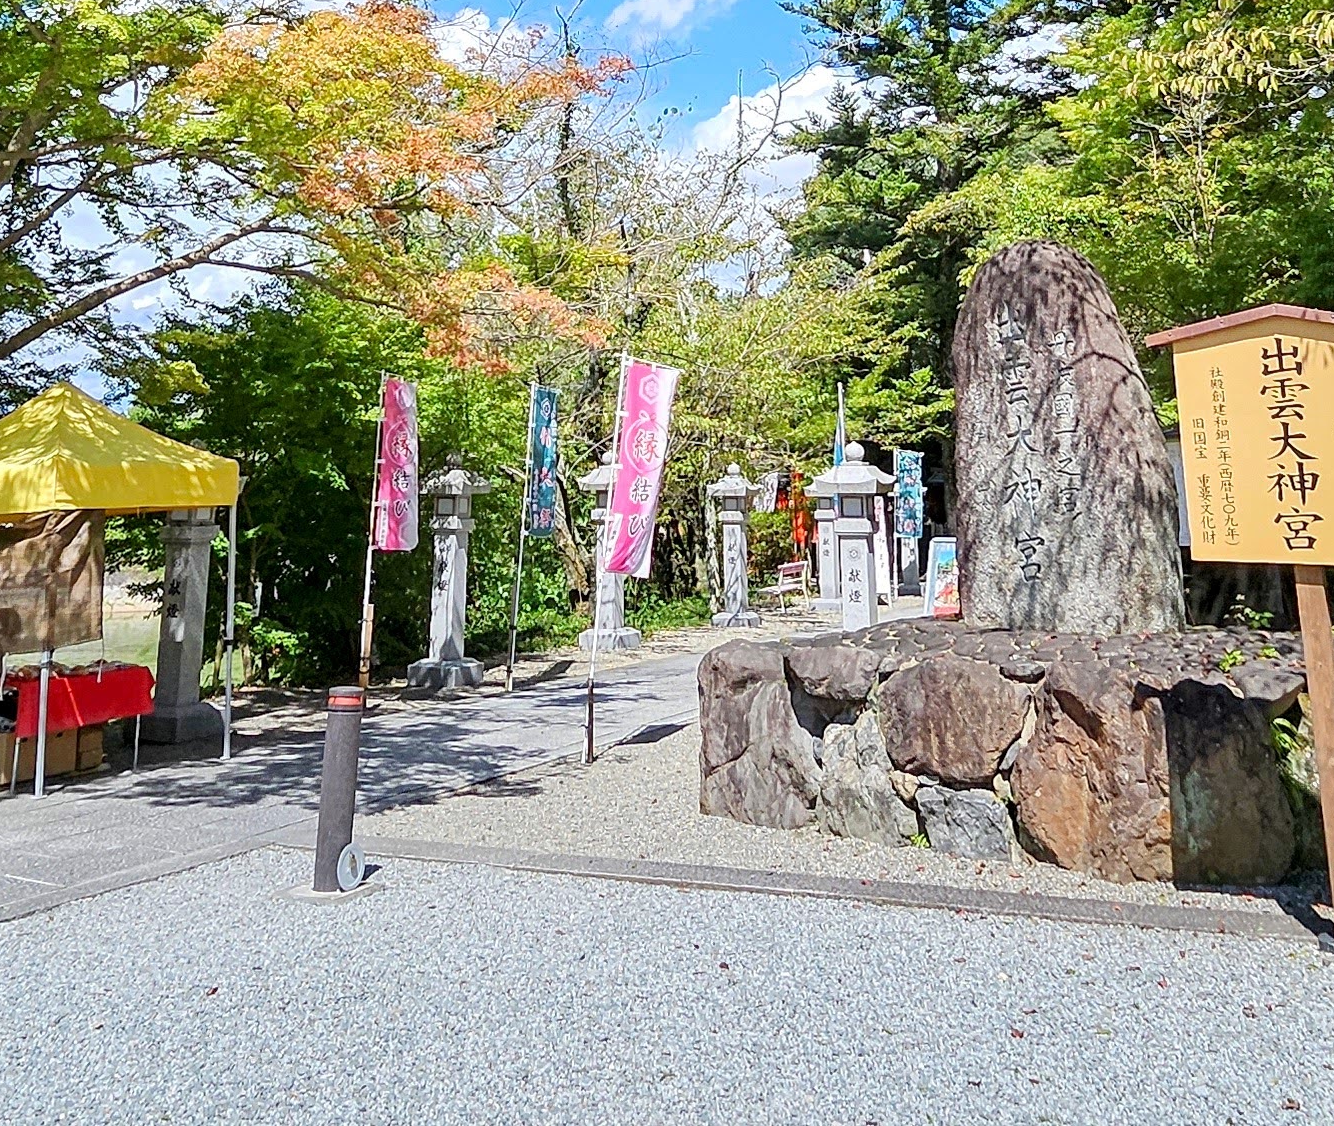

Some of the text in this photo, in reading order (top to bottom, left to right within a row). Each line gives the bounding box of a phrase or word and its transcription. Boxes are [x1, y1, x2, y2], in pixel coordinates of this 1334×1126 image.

[392, 431, 413, 518] 縁結び
[628, 429, 660, 538] 縁結び
[995, 300, 1046, 582] 出雲大神宮
[1192, 417, 1216, 545] 旧国宝 重要文化財
[1260, 337, 1324, 552] 出雲大神宮
[848, 568, 863, 604] 献燈
